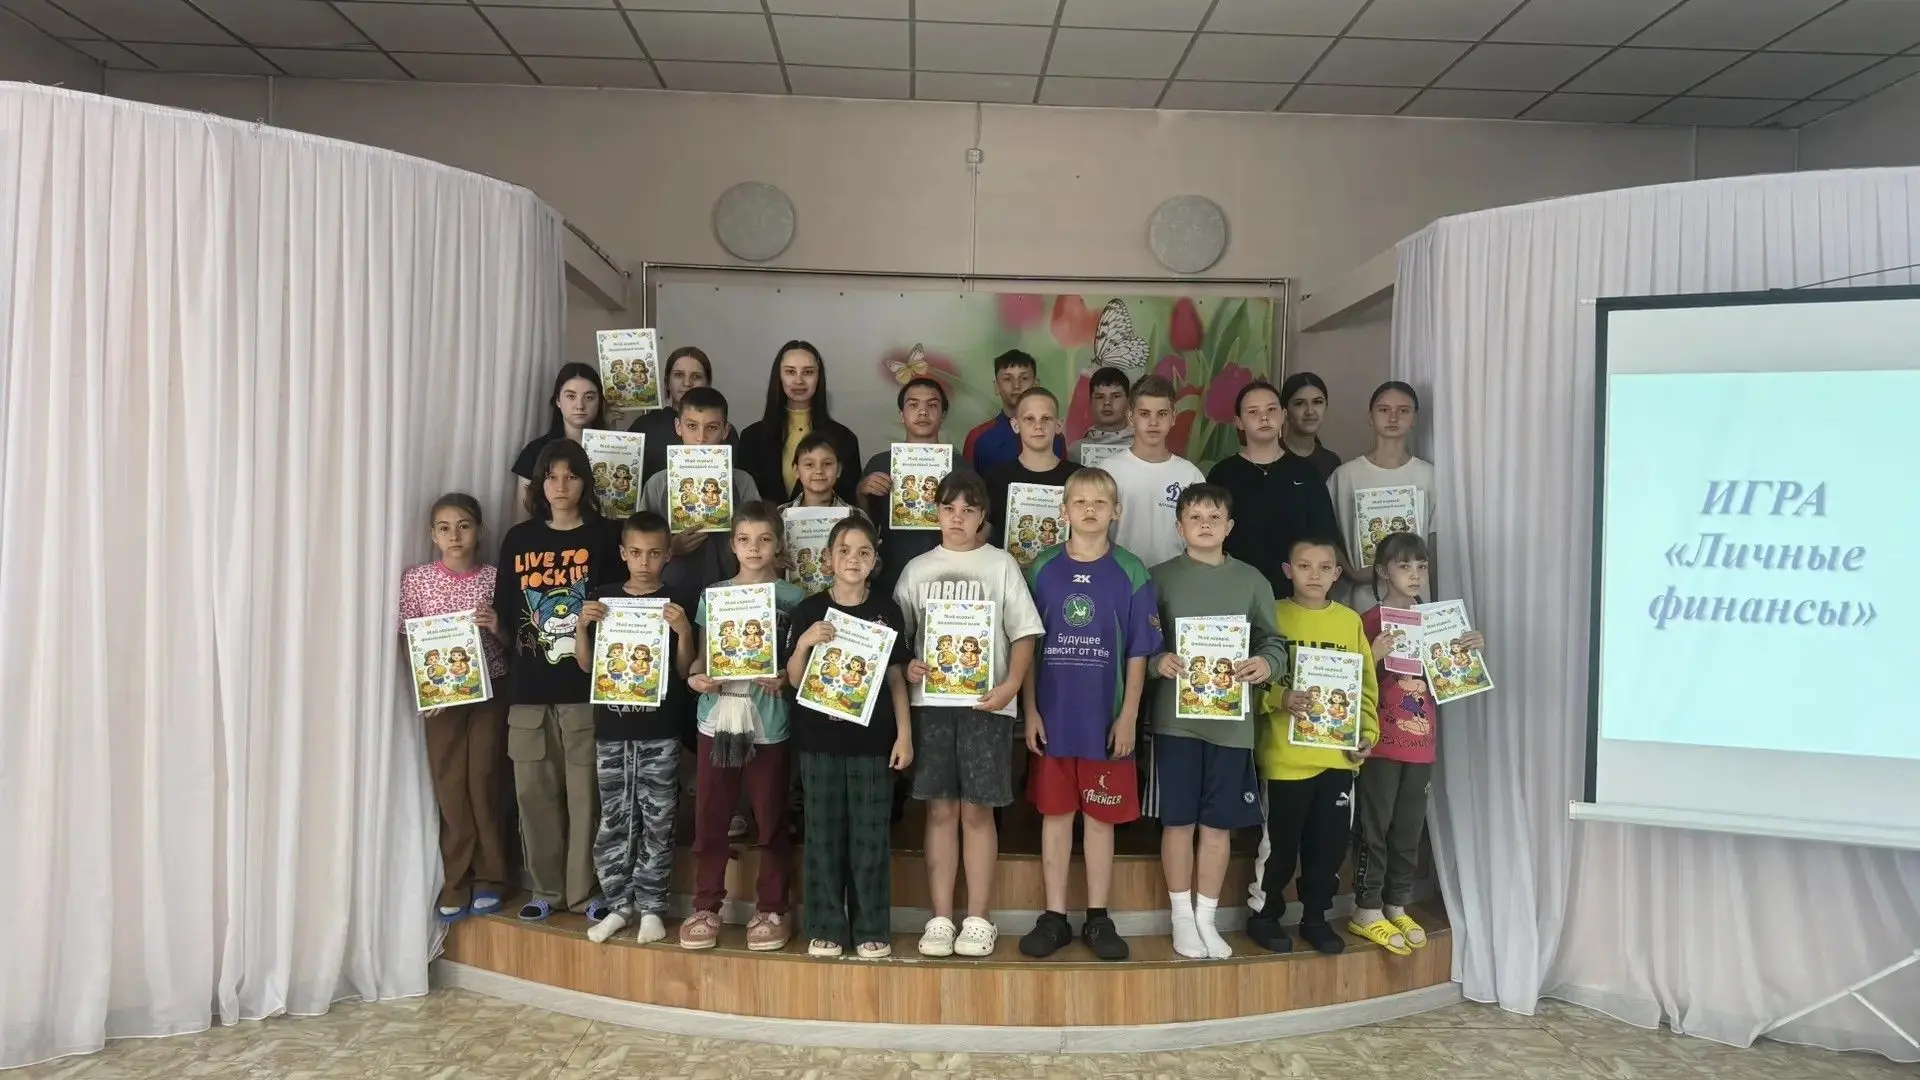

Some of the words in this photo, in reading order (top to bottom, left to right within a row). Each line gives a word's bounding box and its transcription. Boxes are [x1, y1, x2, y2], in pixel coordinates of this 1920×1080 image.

[1700, 480, 1826, 517] ИГРА
[515, 551, 555, 573] LIVE
[561, 548, 589, 566] TO
[1665, 532, 1867, 572] «Личные
[1072, 574, 1091, 584] 2K
[1648, 585, 1876, 630] финансы»
[1078, 648, 1090, 656] от
